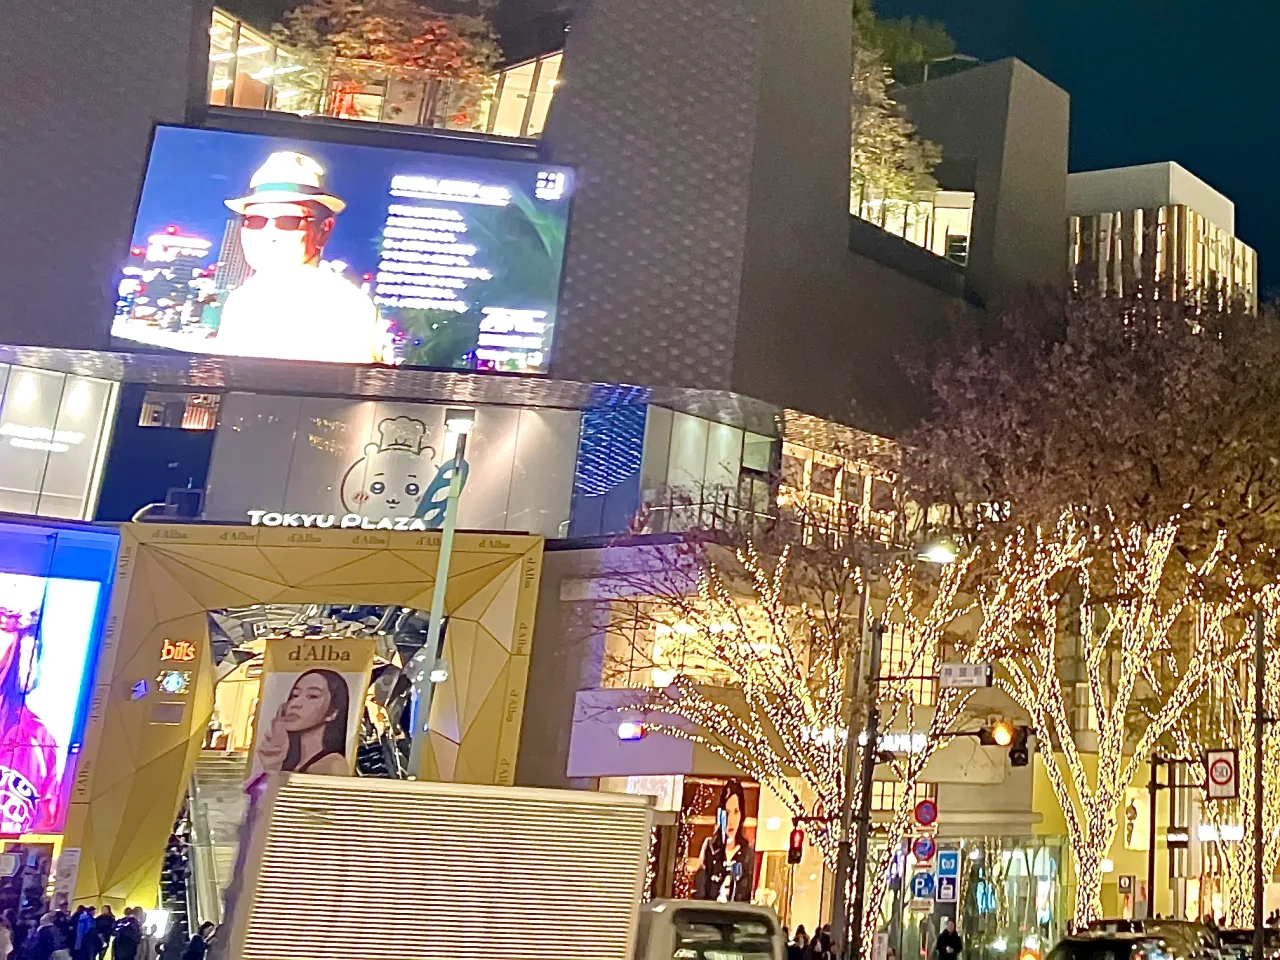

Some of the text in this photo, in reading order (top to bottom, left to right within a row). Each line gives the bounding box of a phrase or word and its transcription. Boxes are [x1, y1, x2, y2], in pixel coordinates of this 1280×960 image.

[247, 510, 426, 531] TOKYU PLAZA
[288, 644, 351, 661] d'Alba
